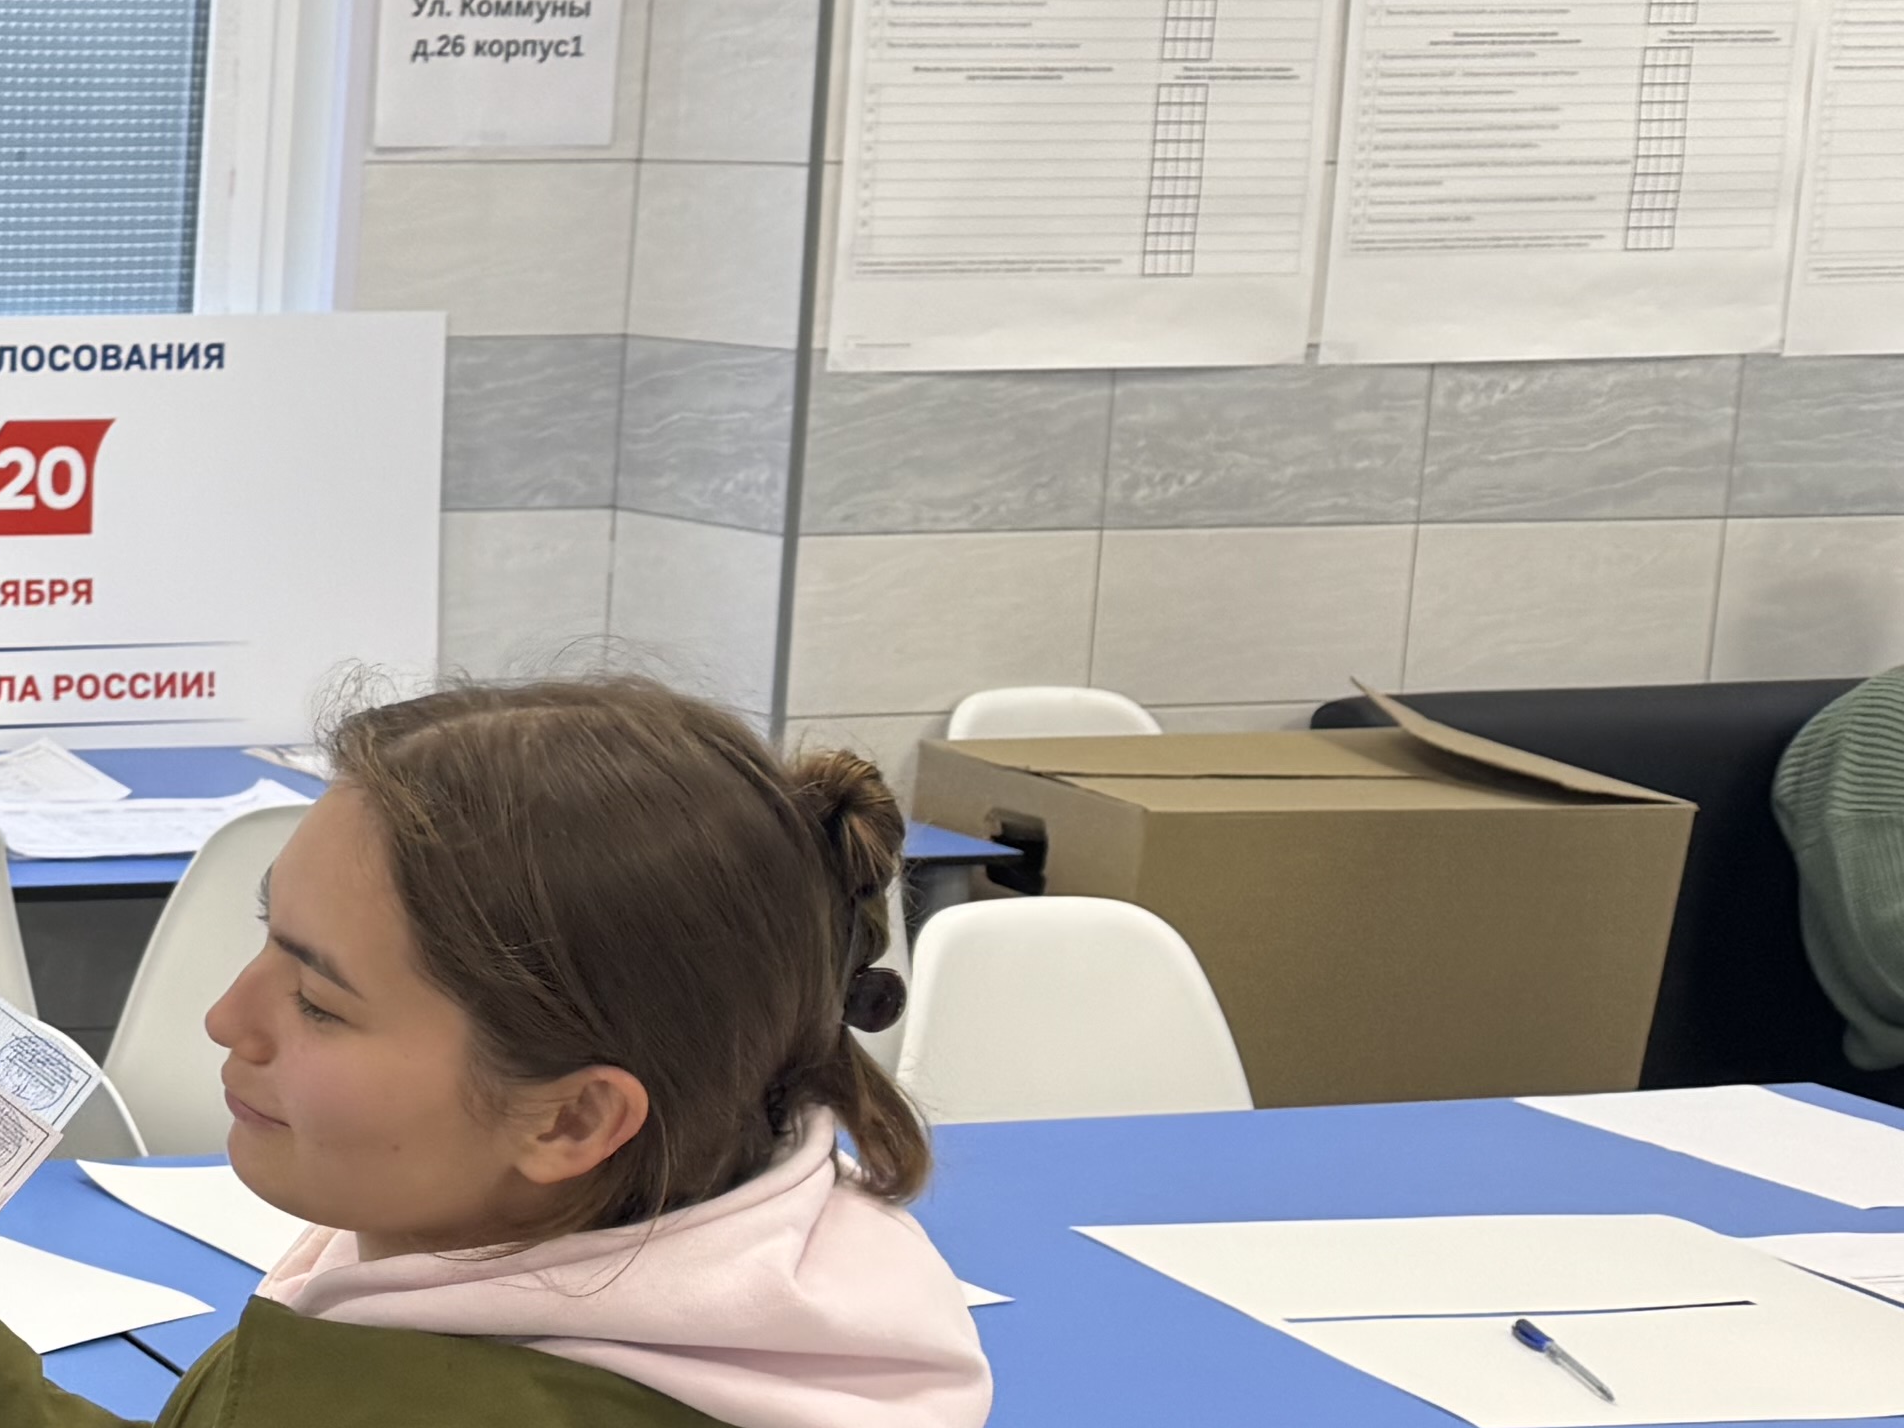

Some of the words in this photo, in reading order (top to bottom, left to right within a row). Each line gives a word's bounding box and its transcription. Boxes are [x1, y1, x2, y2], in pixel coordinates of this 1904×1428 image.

[410, 34, 466, 63] д.26
[473, 35, 585, 63] корпус1
[54, 671, 216, 700] РОССИИ!
